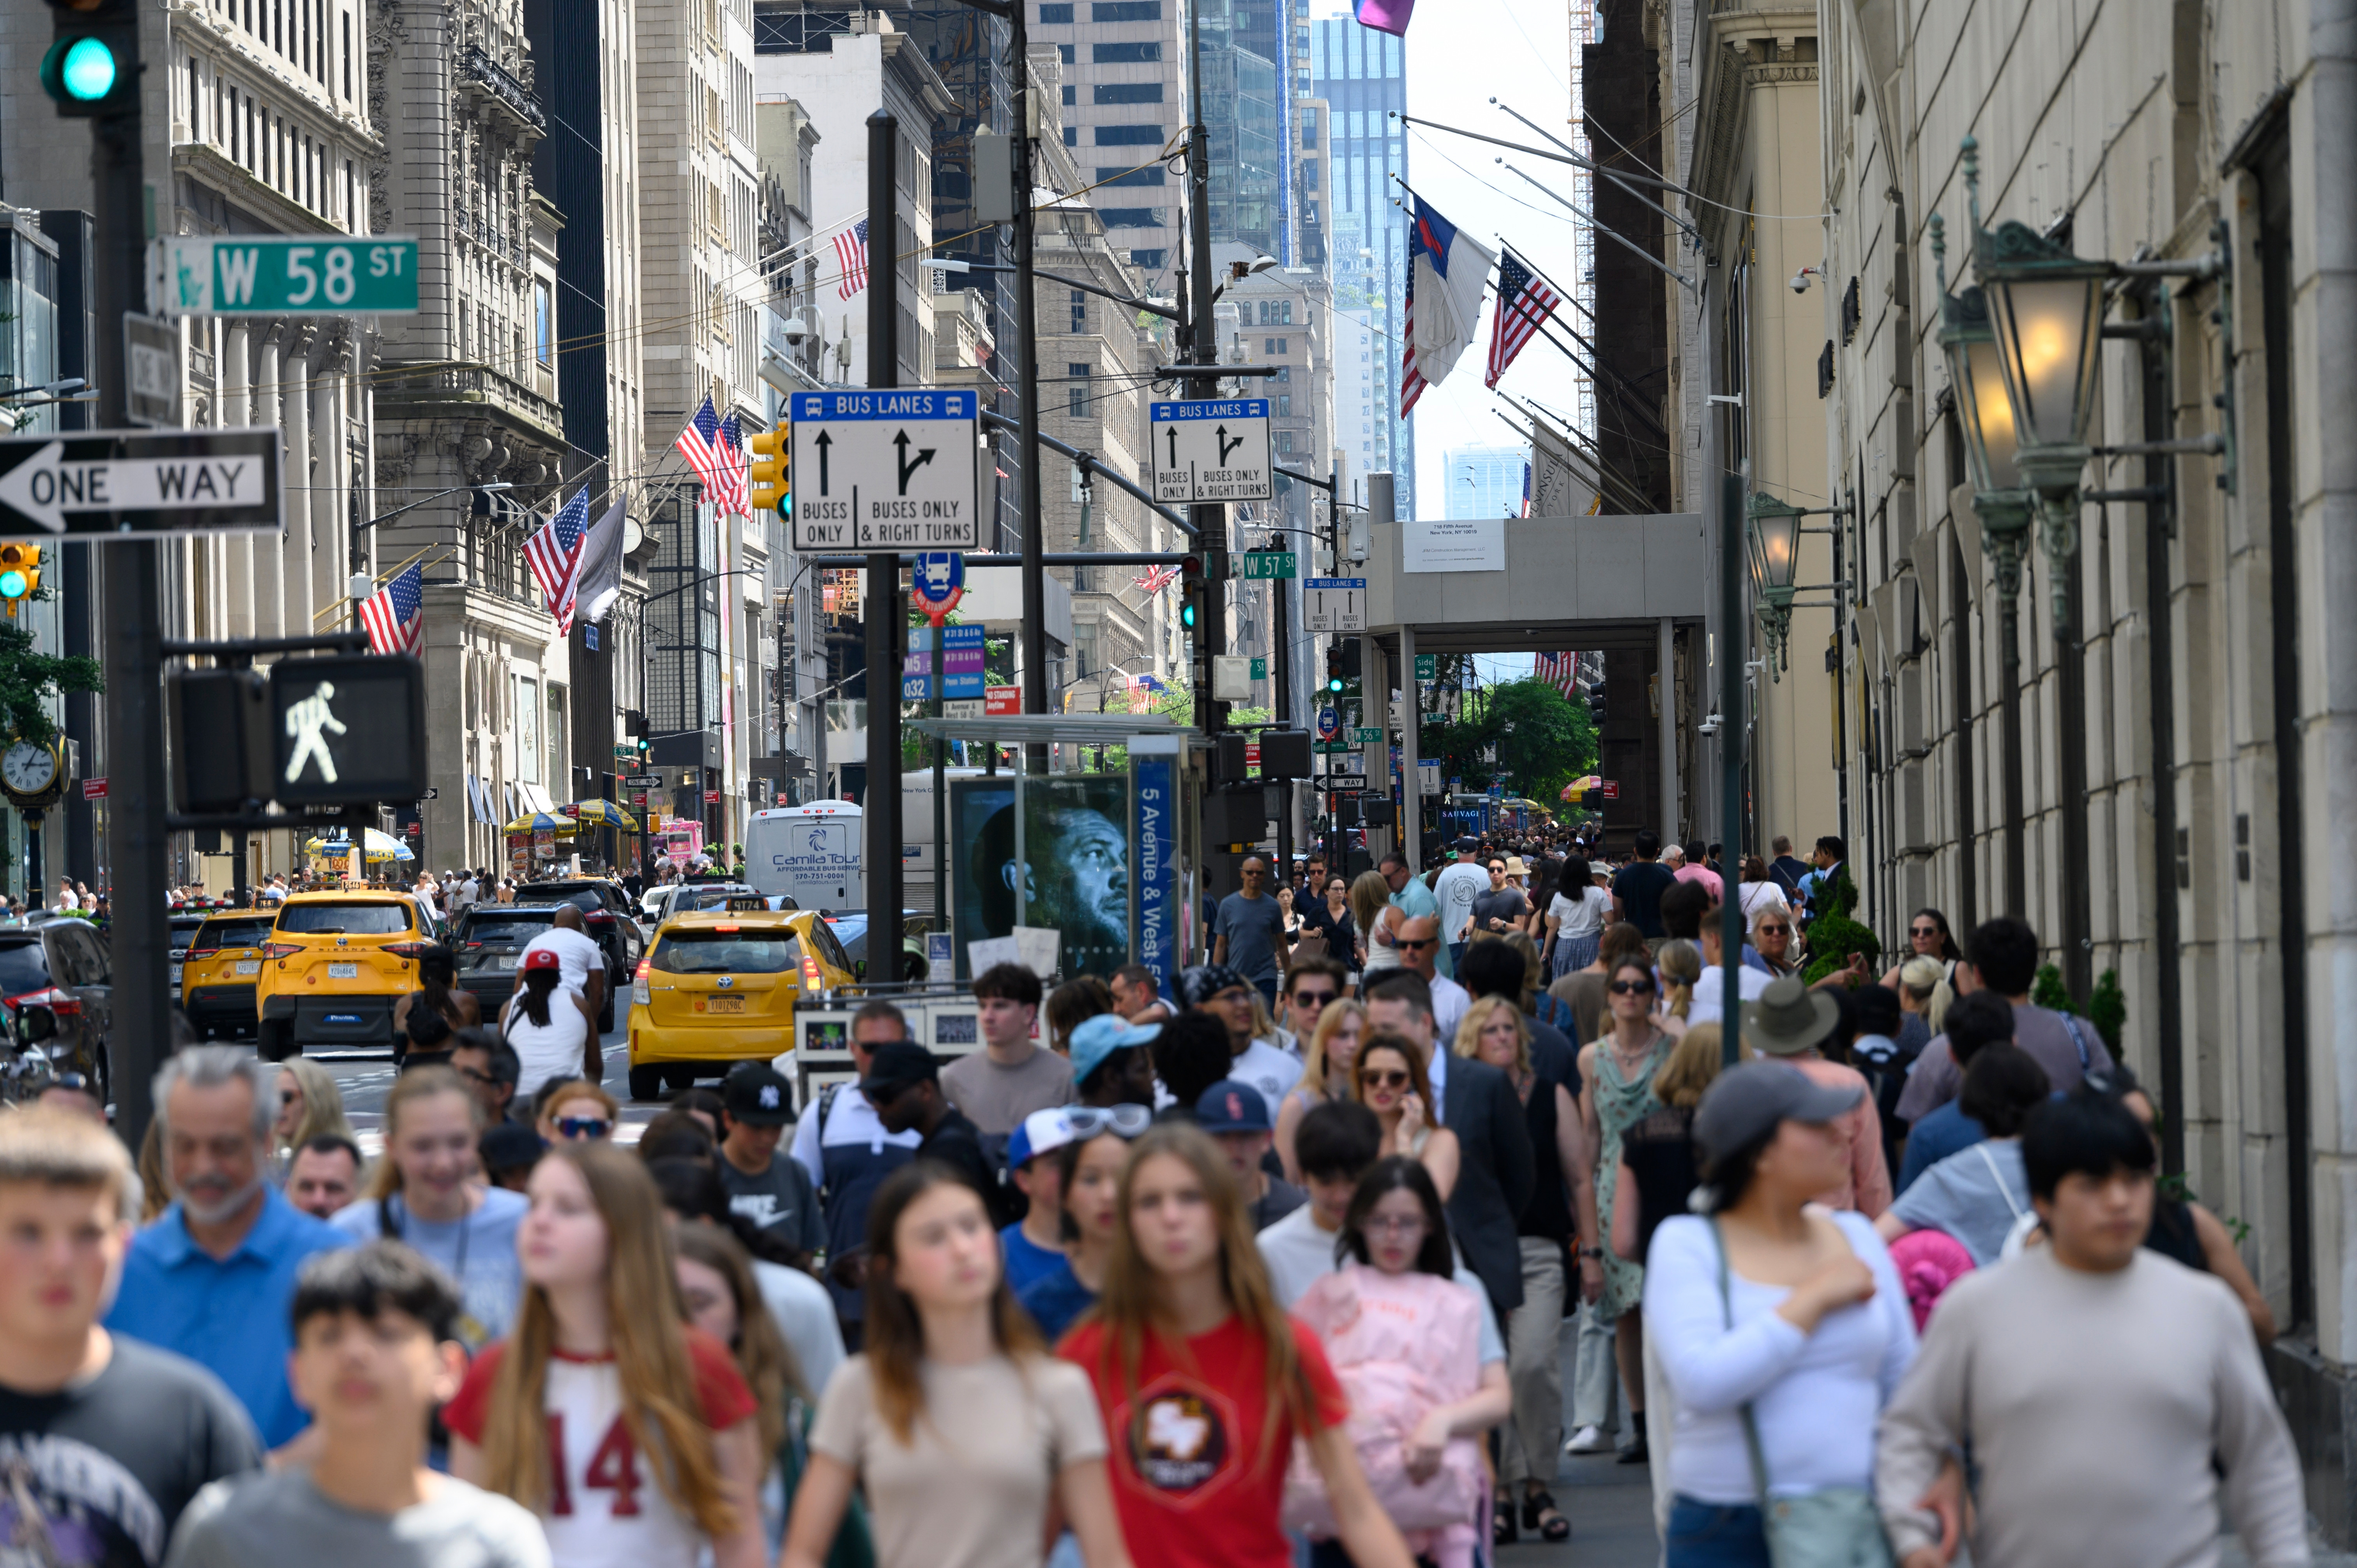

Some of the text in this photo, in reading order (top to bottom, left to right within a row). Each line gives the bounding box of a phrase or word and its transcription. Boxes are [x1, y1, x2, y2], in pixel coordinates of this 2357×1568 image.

[217, 247, 406, 305] W 58 ST
[837, 396, 933, 414] BUS LANES
[1180, 404, 1241, 417] BUS LANES
[32, 463, 245, 505] ONE WAY
[1160, 472, 1188, 483] BUSES
[1204, 470, 1259, 482] BUSES ONLY
[1163, 487, 1185, 498] ONLY
[1197, 484, 1267, 496] & RIGHT TURNS
[1548, 480, 1564, 508] YORK
[803, 503, 847, 519] BUSES
[873, 501, 959, 518] BUSES ONLY
[808, 526, 842, 542] ONLY
[862, 524, 970, 541] & RIGHT TURNS
[1247, 555, 1294, 576] W 57 St
[916, 589, 958, 612] NO STANDING
[944, 629, 950, 638] W
[904, 655, 921, 672] M5
[1257, 662, 1264, 671] St
[904, 679, 925, 697] Q32
[987, 690, 1016, 699] NO STANDING
[987, 701, 1005, 710] Anytime
[1355, 730, 1361, 740] W
[1364, 730, 1373, 740] 56
[1142, 788, 1160, 801] 5
[1142, 805, 1160, 881] Avenue
[773, 854, 860, 865] Camila Tour
[1143, 886, 1161, 901] &
[734, 901, 760, 910] 9T74
[1143, 906, 1161, 958] West
[759, 1084, 780, 1109] NY
[548, 1411, 641, 1516] 14
